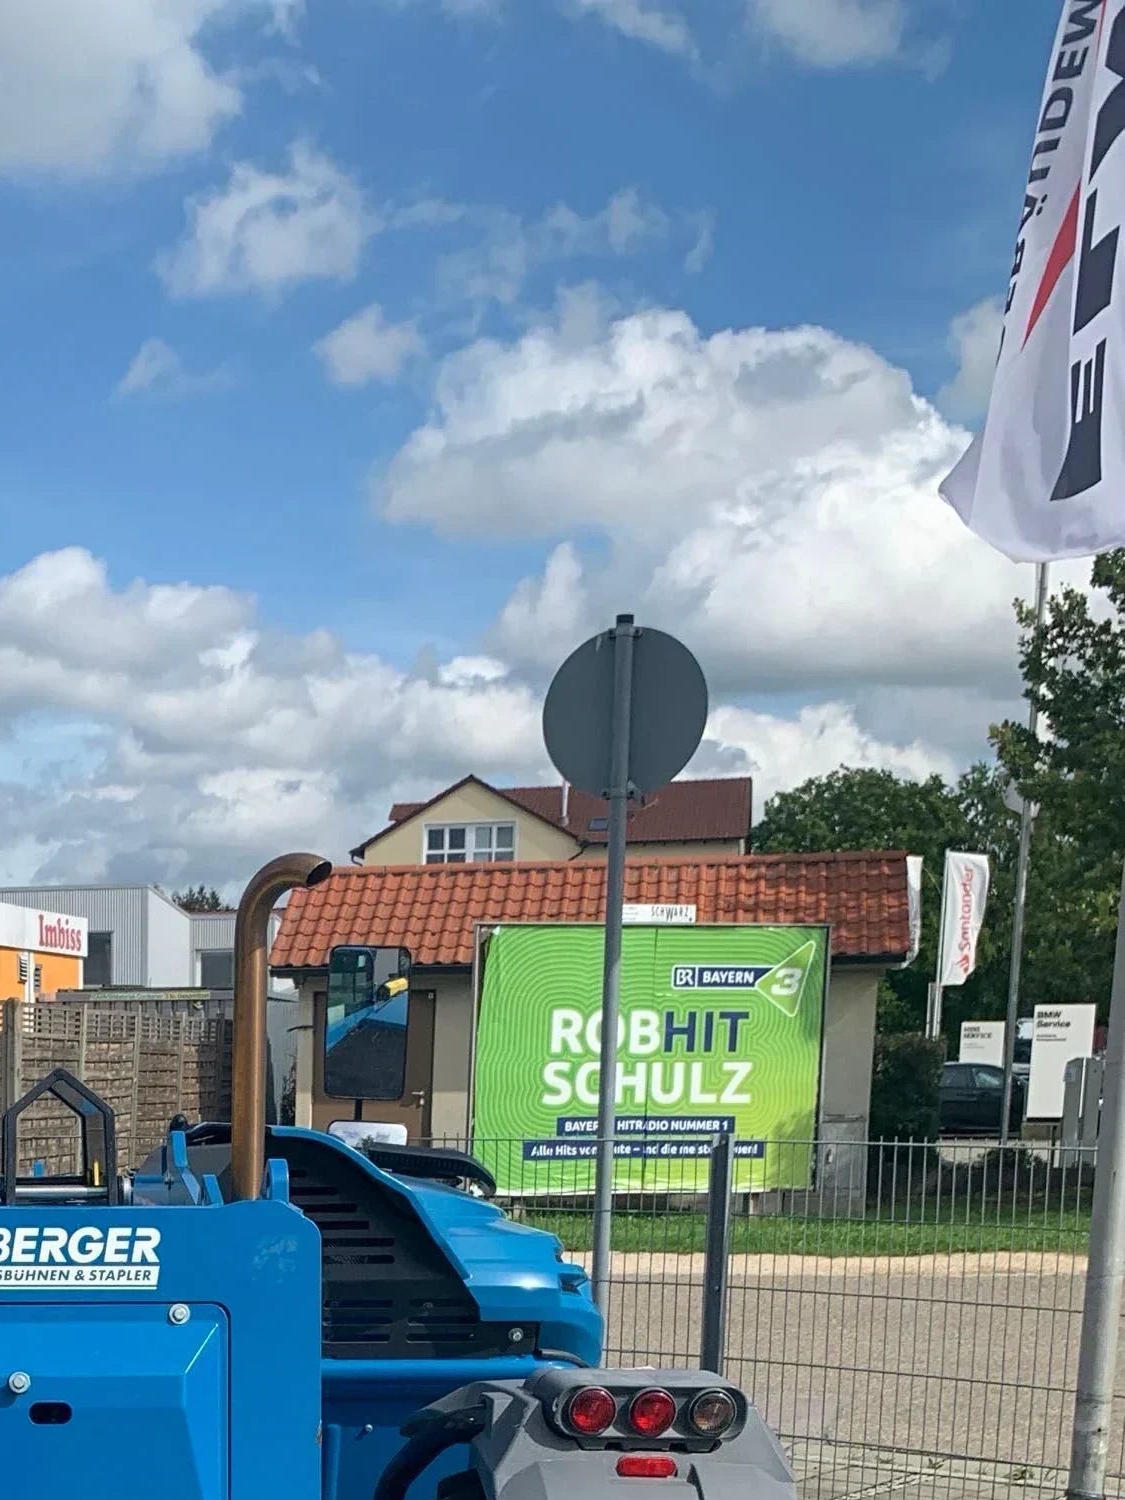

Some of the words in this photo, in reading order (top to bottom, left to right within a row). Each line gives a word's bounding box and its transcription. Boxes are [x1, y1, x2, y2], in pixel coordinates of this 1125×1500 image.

[651, 906, 690, 921] SCHWARZ
[958, 865, 974, 952] Santander
[38, 914, 82, 951] Imbiss
[675, 968, 694, 986] BR
[702, 971, 755, 984] BAYERN
[770, 967, 803, 996] 3
[1037, 1020, 1072, 1029] Service
[542, 1060, 753, 1105] SCHULZ
[617, 1119, 670, 1132] HITRADIO
[670, 1119, 721, 1131] NUMMER
[722, 1119, 728, 1131] 1
[531, 1145, 553, 1157] Alle
[555, 1145, 578, 1156] Hits
[661, 1143, 677, 1154] die
[74, 1269, 86, 1281] &
[88, 1268, 152, 1282] STAPLER
